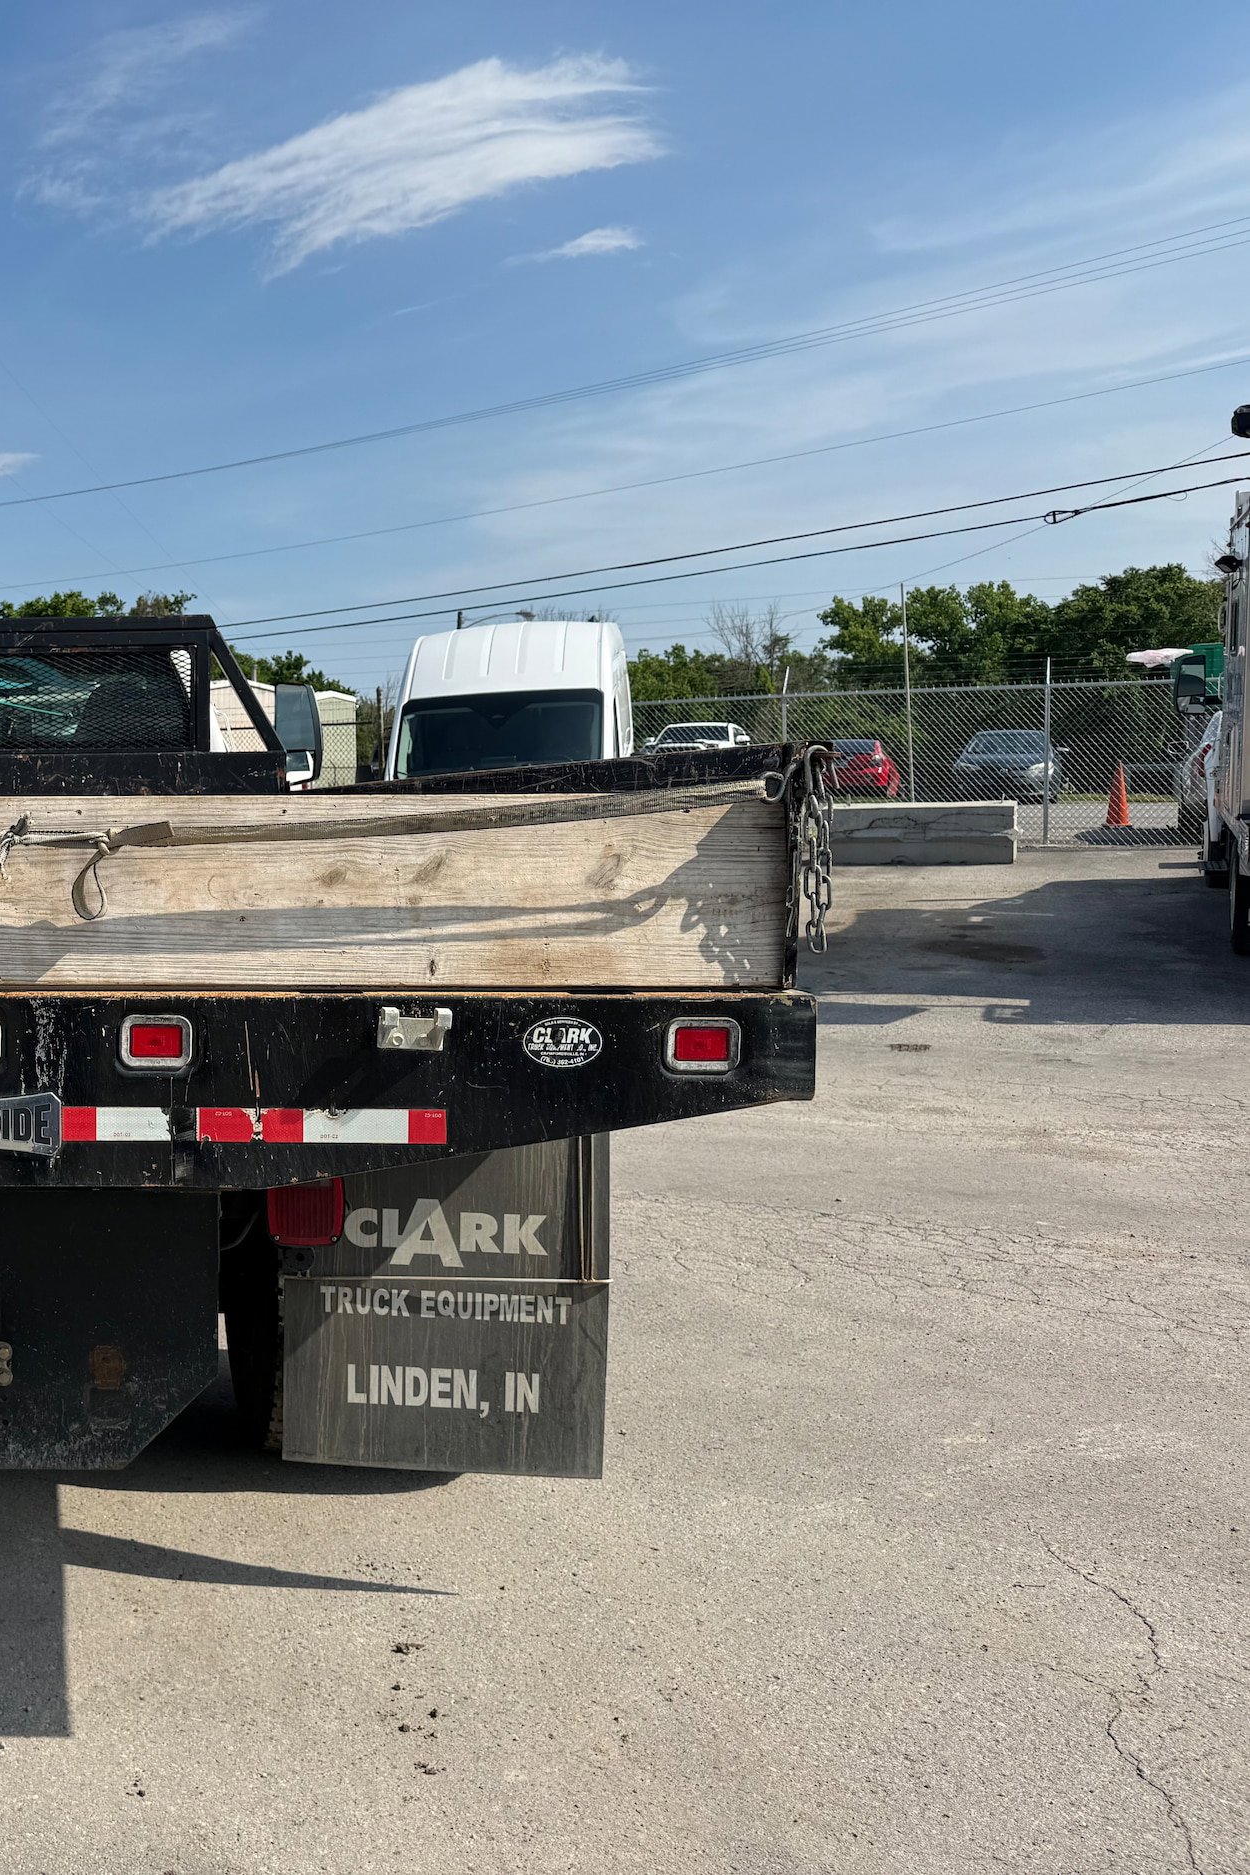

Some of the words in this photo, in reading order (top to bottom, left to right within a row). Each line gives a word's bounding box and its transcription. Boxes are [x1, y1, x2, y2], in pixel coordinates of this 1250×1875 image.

[344, 1198, 548, 1267] CLARK
[320, 1286, 410, 1317] TRUCK
[420, 1290, 572, 1325] EQUIPMENT
[347, 1364, 489, 1418] LINDEN,
[505, 1371, 540, 1413] IN
